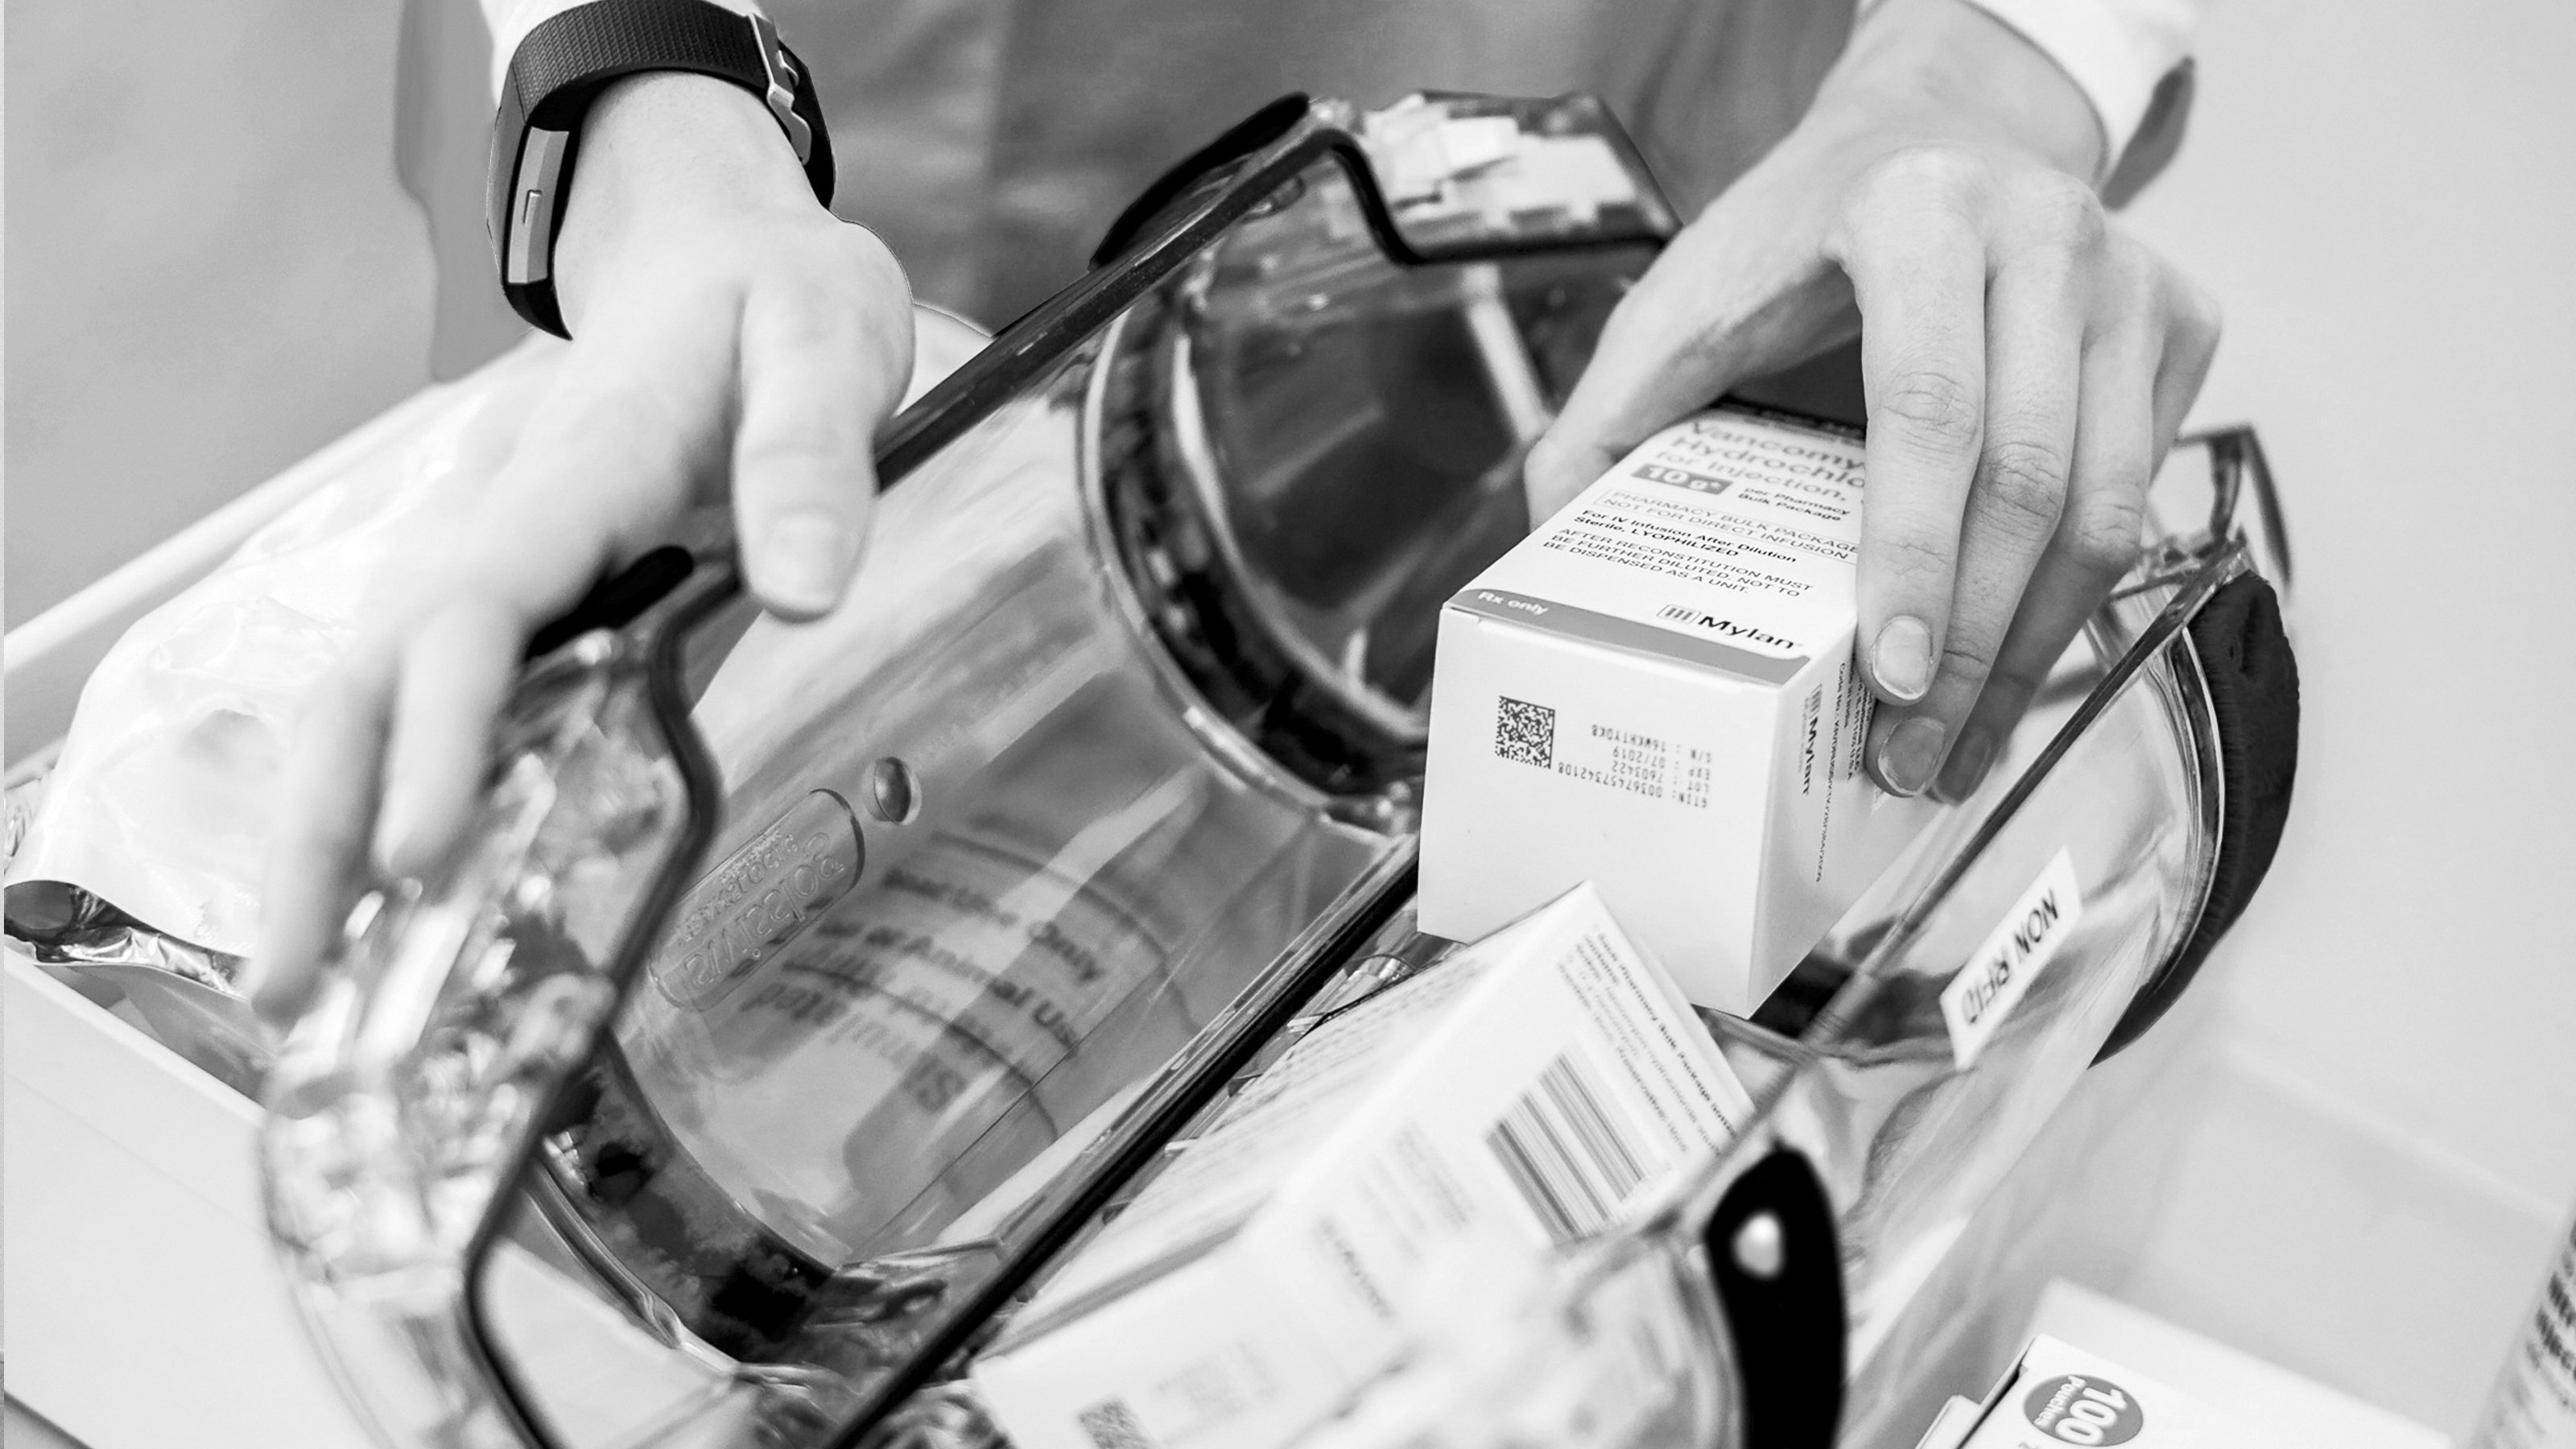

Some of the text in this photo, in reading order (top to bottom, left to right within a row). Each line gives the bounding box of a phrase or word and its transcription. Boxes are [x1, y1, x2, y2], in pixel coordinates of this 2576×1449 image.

[1656, 450, 1699, 465] for
[1672, 437, 1864, 488] Hydrochlo
[1694, 421, 1864, 470] Vancomy
[1648, 465, 1690, 484] 10
[1738, 493, 1842, 522] Bulk Package
[1744, 487, 1851, 516] per Pharmacy
[1583, 509, 1797, 564] For IV Infusion After Dilution
[1604, 498, 1849, 560] NOT FOR DIRECT INFUSION
[1613, 491, 1860, 554] PHARMACY BULK PACKAGE
[1543, 542, 1567, 551] BE
[1569, 547, 1664, 572] DISPENSED
[1666, 568, 1690, 579] AS
[1558, 528, 1814, 591] AFTER RECONSTITUTION MUST
[1631, 528, 1739, 557] LYOPHILIZED
[1551, 535, 1575, 544] BE
[1577, 539, 1655, 562] FURTHER
[1737, 576, 1775, 589] NOT
[1777, 586, 1800, 597] TO
[1477, 590, 1550, 616] Rx only
[1698, 615, 1797, 650] Mylan
[1837, 663, 1846, 693] Code
[1612, 745, 1666, 770] 07/2019
[1612, 759, 1664, 784] 7603422
[1802, 716, 1818, 795] Mylan
[1671, 789, 1707, 809] GTIN:
[1688, 780, 1710, 795] LOT
[898, 936, 1037, 1009] Animal
[1961, 888, 2059, 1026] NON RFID
[2033, 1374, 2087, 1430] Pouches
[2054, 1387, 2128, 1447] 100
